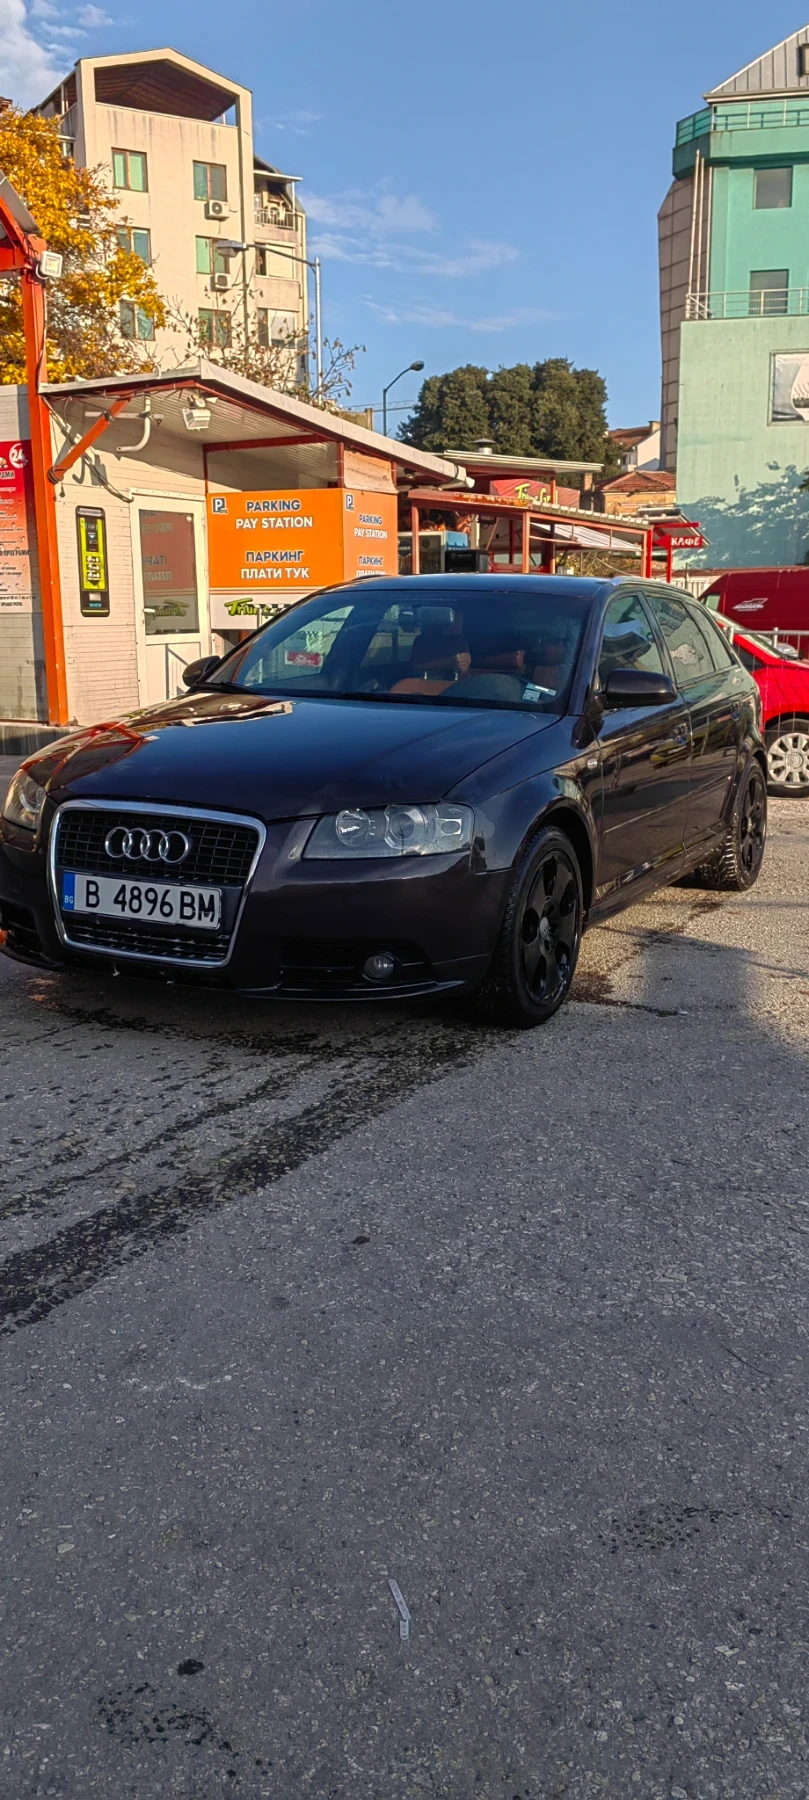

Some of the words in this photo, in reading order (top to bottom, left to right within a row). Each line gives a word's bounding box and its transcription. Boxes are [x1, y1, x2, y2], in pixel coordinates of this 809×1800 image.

[246, 500, 300, 512] PARKING
[236, 518, 258, 529] PAY
[261, 517, 313, 529] STATION
[359, 514, 383, 525] PARKING
[354, 528, 365, 538] PAY
[365, 529, 388, 539] STATION
[671, 537, 700, 546] КАФЕ
[246, 551, 304, 562] ПАРКИНГ
[359, 556, 383, 566] ПАРКИНГ
[241, 568, 282, 579] ПЛАТИ
[285, 567, 310, 579] ТУК
[64, 895, 74, 904] BG
[85, 880, 100, 908] B
[113, 884, 174, 918] 4896
[179, 891, 215, 922] BM
